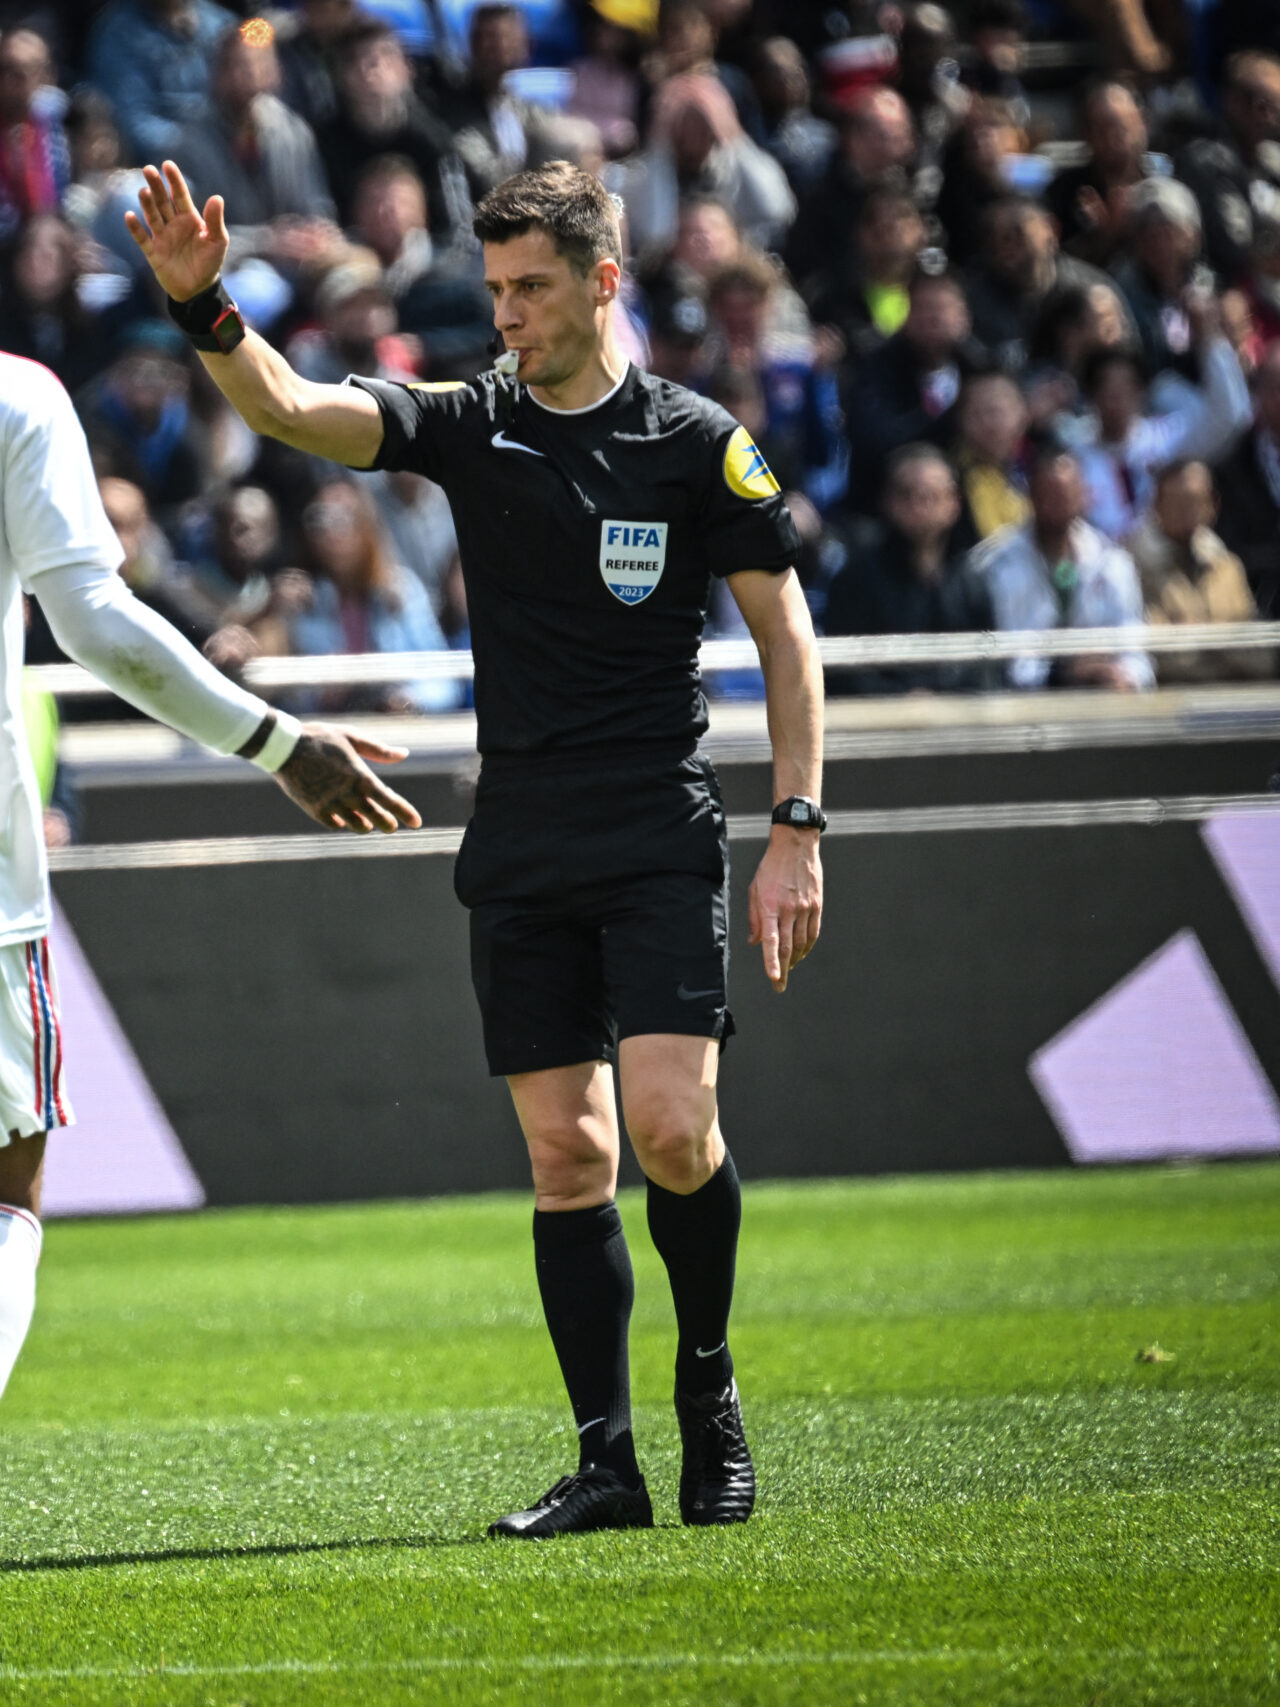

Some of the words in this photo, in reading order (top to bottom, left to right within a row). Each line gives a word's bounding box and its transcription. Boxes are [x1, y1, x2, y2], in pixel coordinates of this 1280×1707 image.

[607, 526, 660, 548] FIFA
[605, 558, 659, 571] REFEREE
[618, 586, 645, 598] 2023
